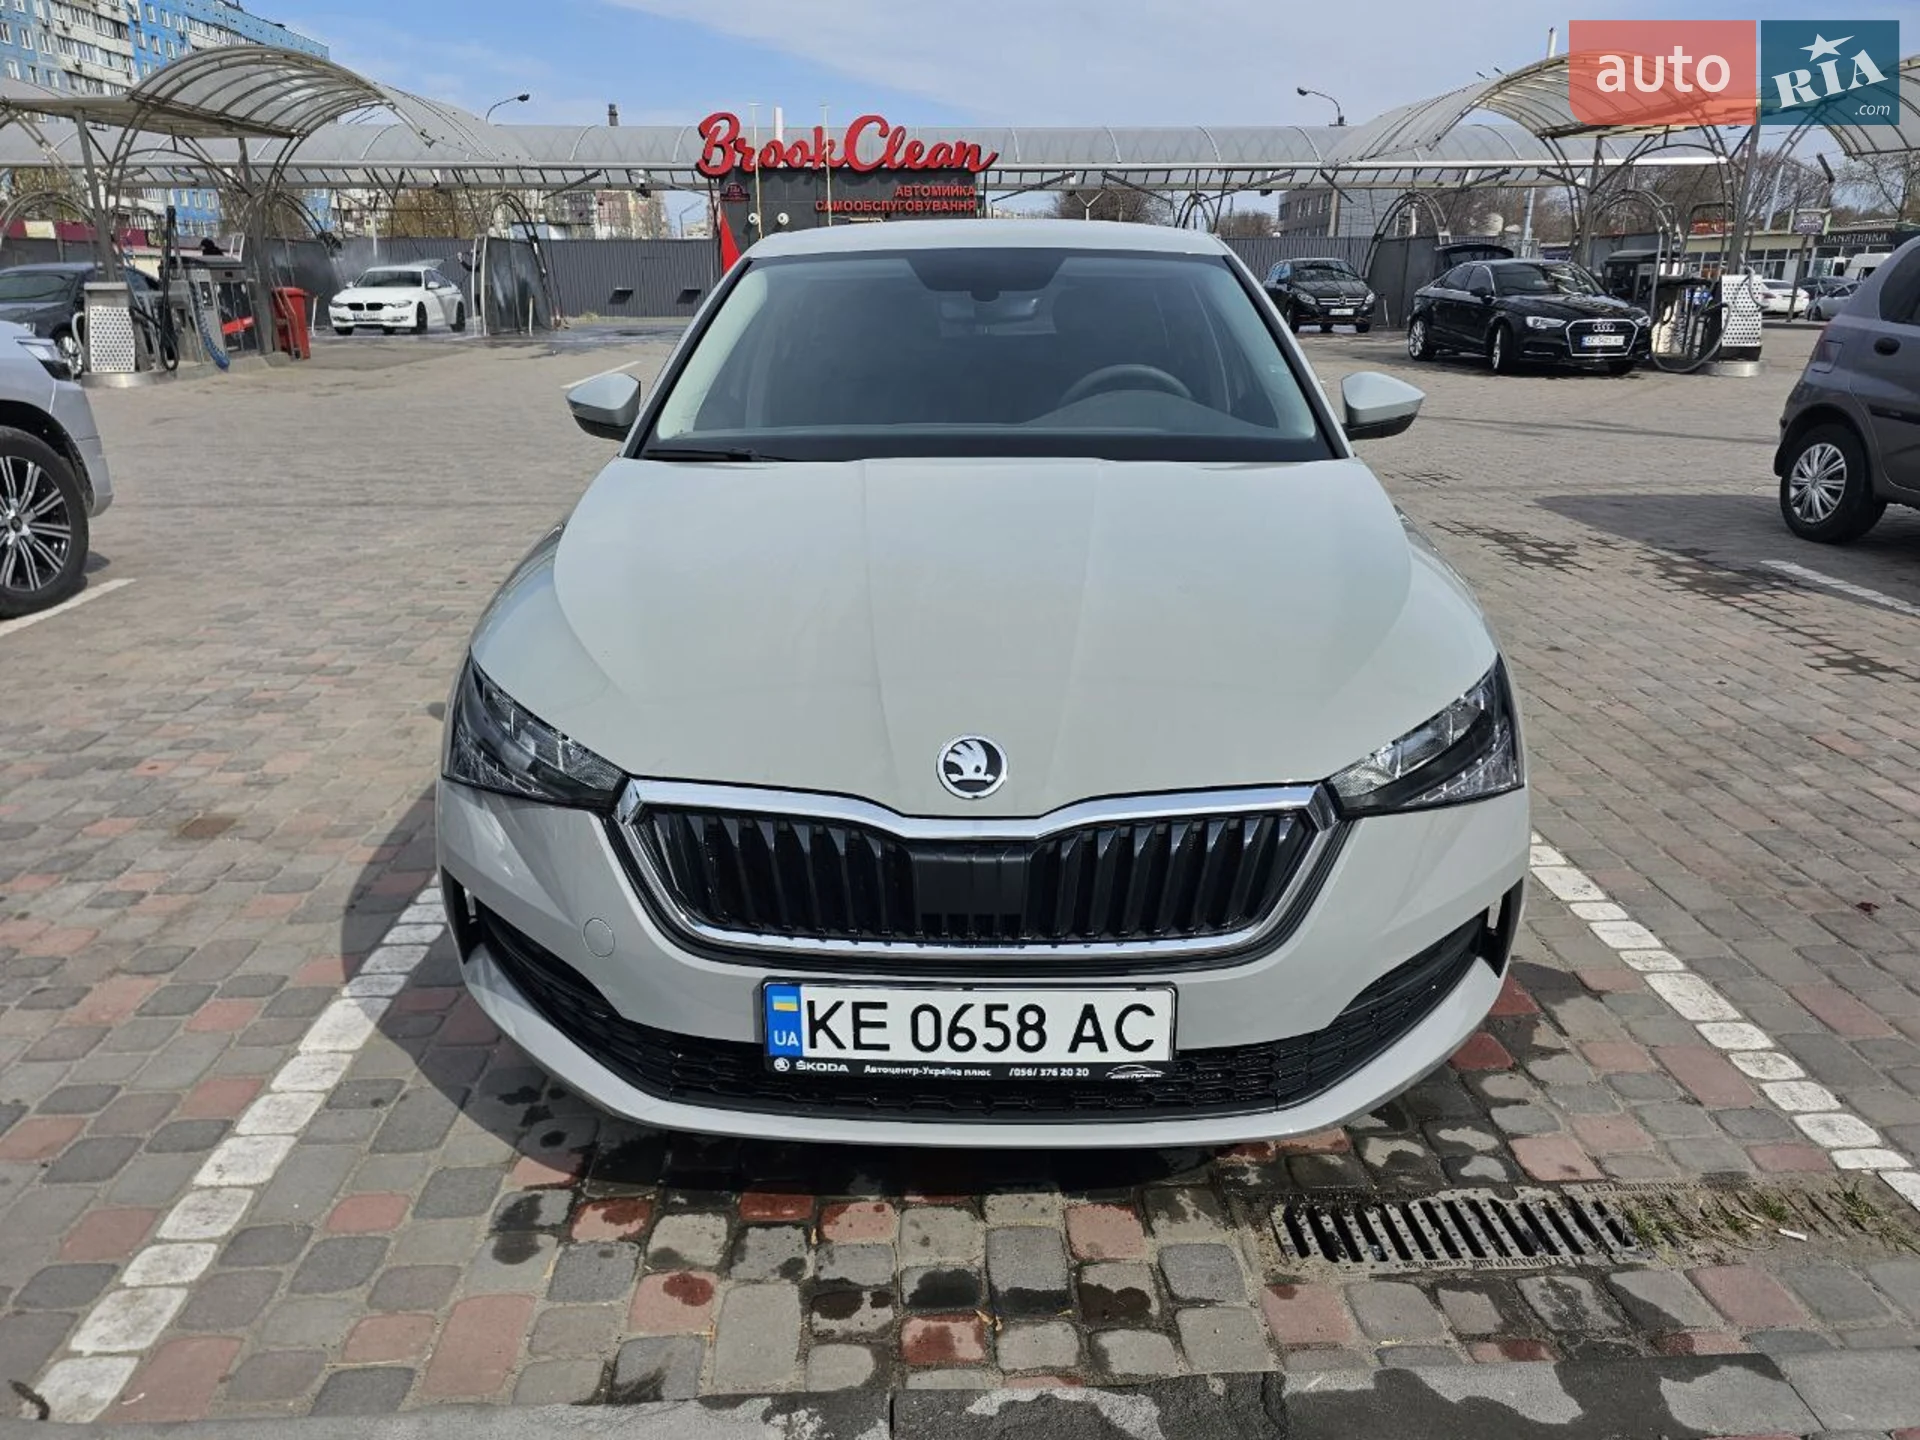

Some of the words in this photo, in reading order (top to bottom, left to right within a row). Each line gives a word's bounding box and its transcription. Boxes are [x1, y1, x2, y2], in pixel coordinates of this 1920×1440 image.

[806, 1001, 890, 1051] KE
[910, 1003, 1047, 1053] 0658
[1068, 1003, 1155, 1053] AC
[774, 1030, 799, 1047] UA
[795, 1060, 849, 1072] ŠKODA
[1040, 1067, 1059, 1077] 376
[1060, 1067, 1074, 1077] 20
[1076, 1067, 1090, 1077] 20
[963, 1068, 992, 1077] плюс
